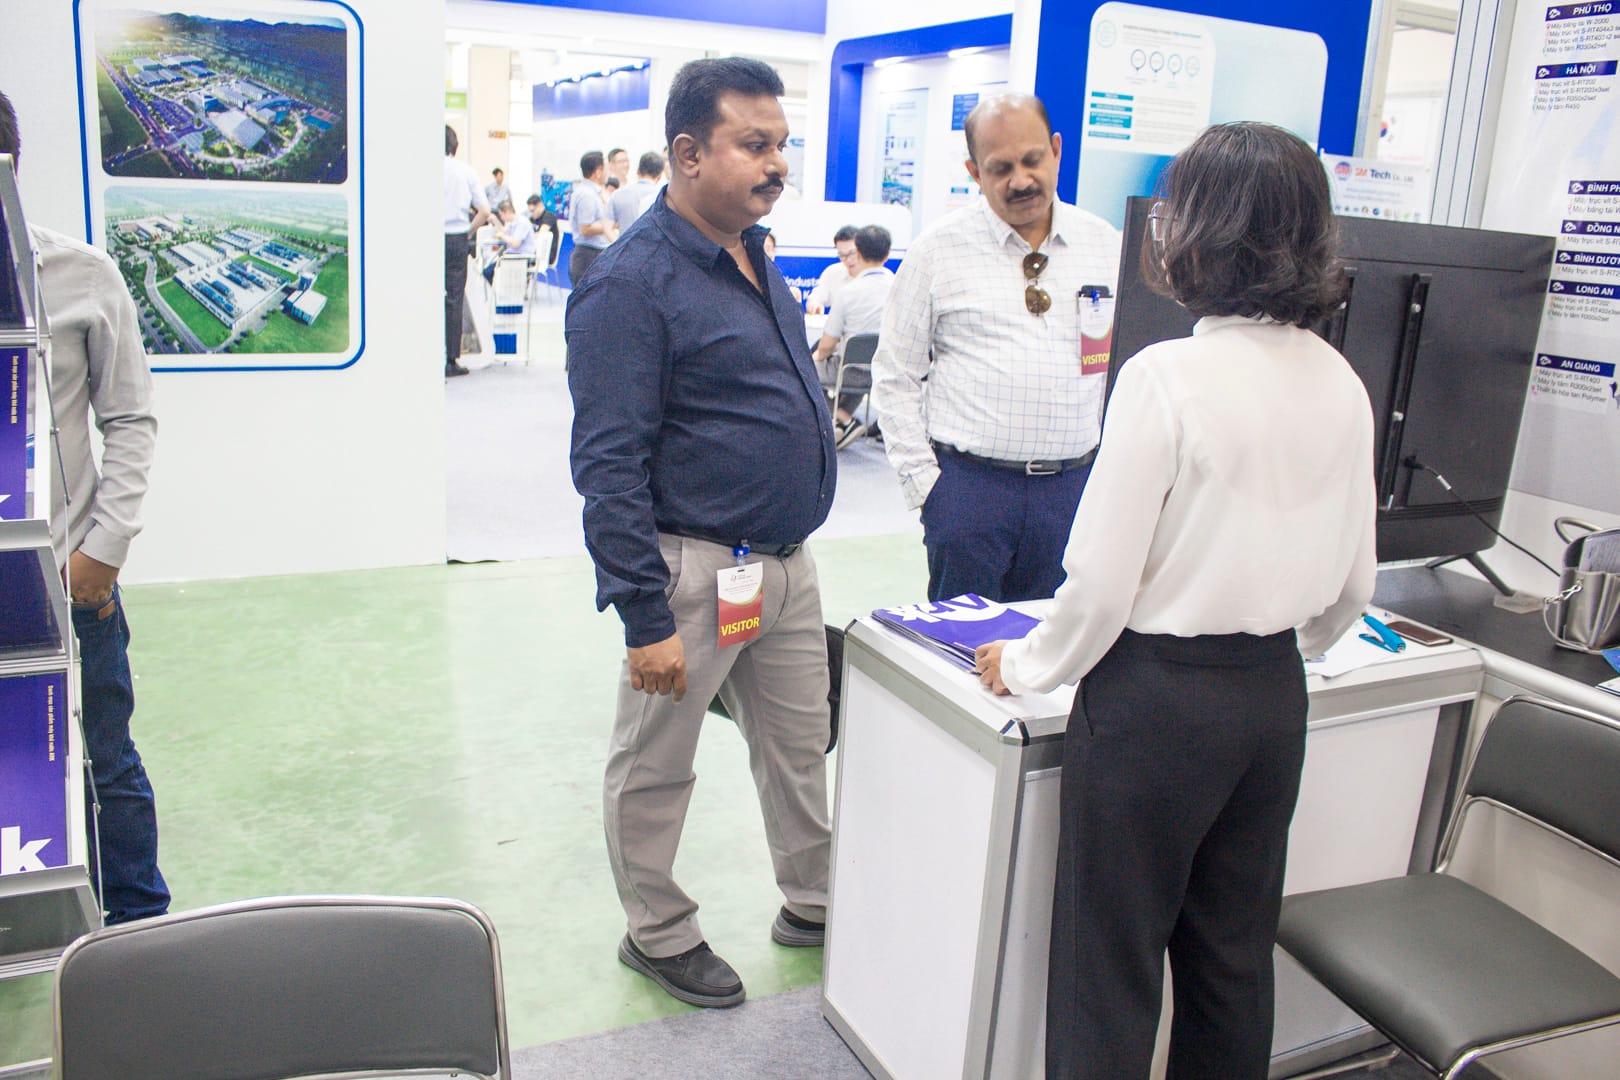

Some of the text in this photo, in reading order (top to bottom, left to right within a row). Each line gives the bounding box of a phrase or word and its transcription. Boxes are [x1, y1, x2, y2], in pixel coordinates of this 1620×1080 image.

[1579, 63, 1597, 74] NỘI
[1370, 168, 1391, 179] Tech
[1587, 182, 1609, 193] BÌNH
[1576, 284, 1614, 296] LONG AN
[1561, 359, 1601, 372] AN GIANG
[721, 616, 760, 637] VISITOR
